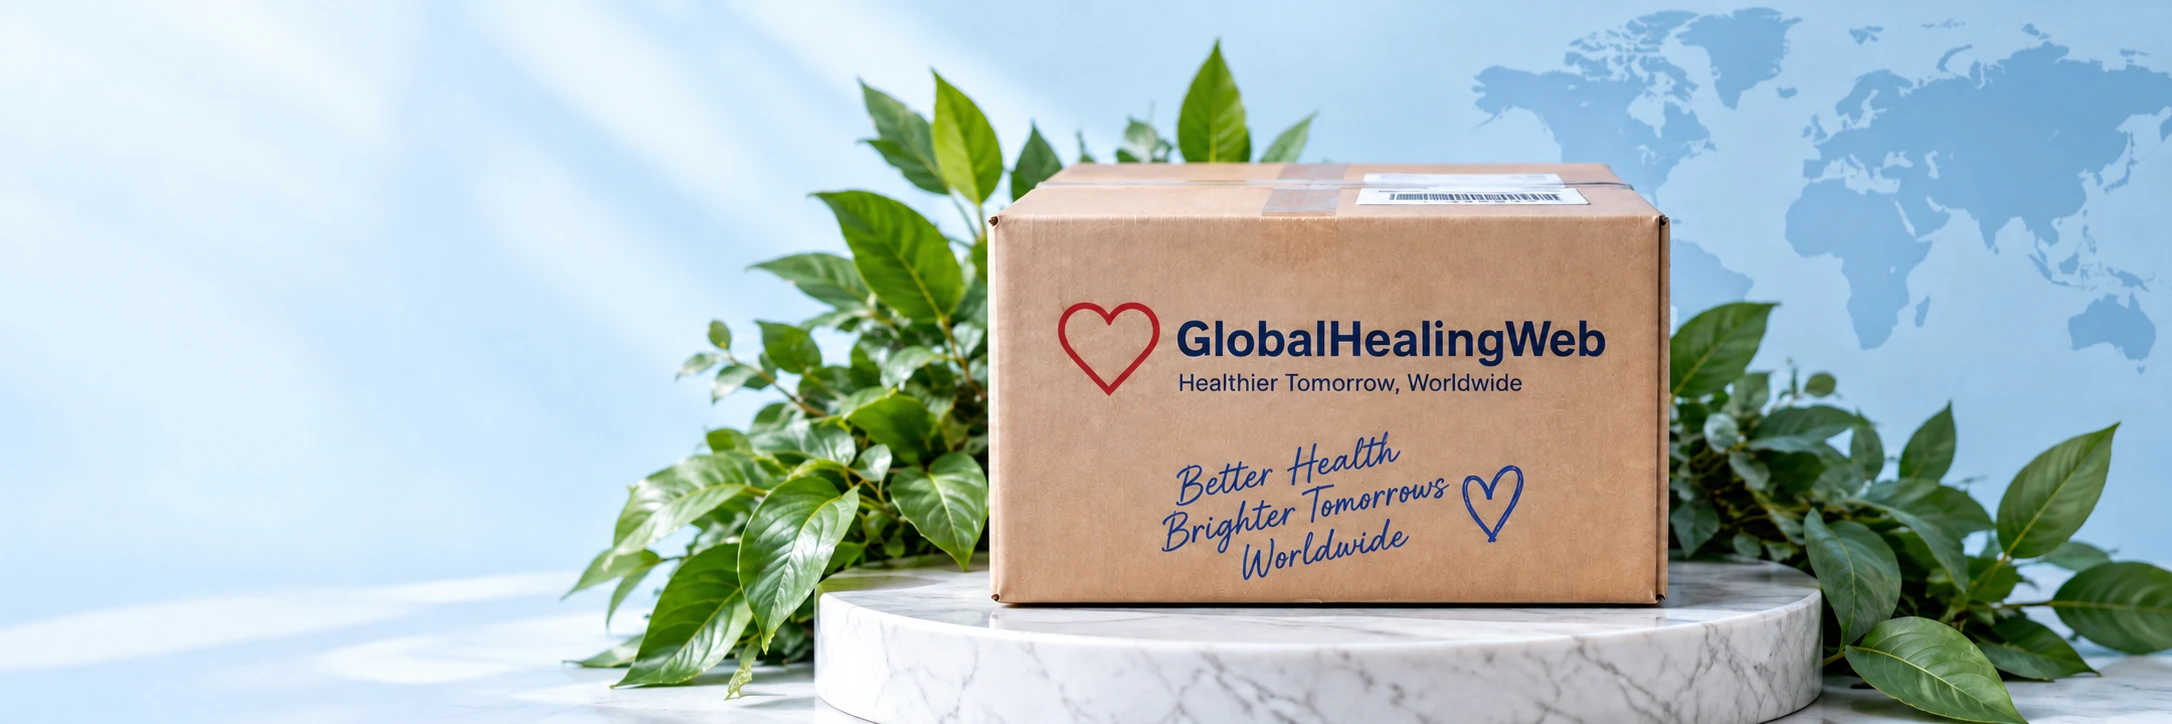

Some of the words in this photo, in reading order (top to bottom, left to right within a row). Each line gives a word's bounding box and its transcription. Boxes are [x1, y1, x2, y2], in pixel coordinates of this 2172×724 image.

[1177, 320, 1606, 366] GlobalHealingWeb
[1179, 373, 1278, 392] Healthier
[1285, 373, 1400, 395] Tomorrow,
[1408, 373, 1522, 392] Worldwide
[1176, 461, 1273, 506] Better
[1287, 431, 1400, 486] Health
[1162, 500, 1296, 554] Brighter
[1302, 477, 1449, 523] Tomorrows
[1242, 518, 1409, 580] Worldwide
